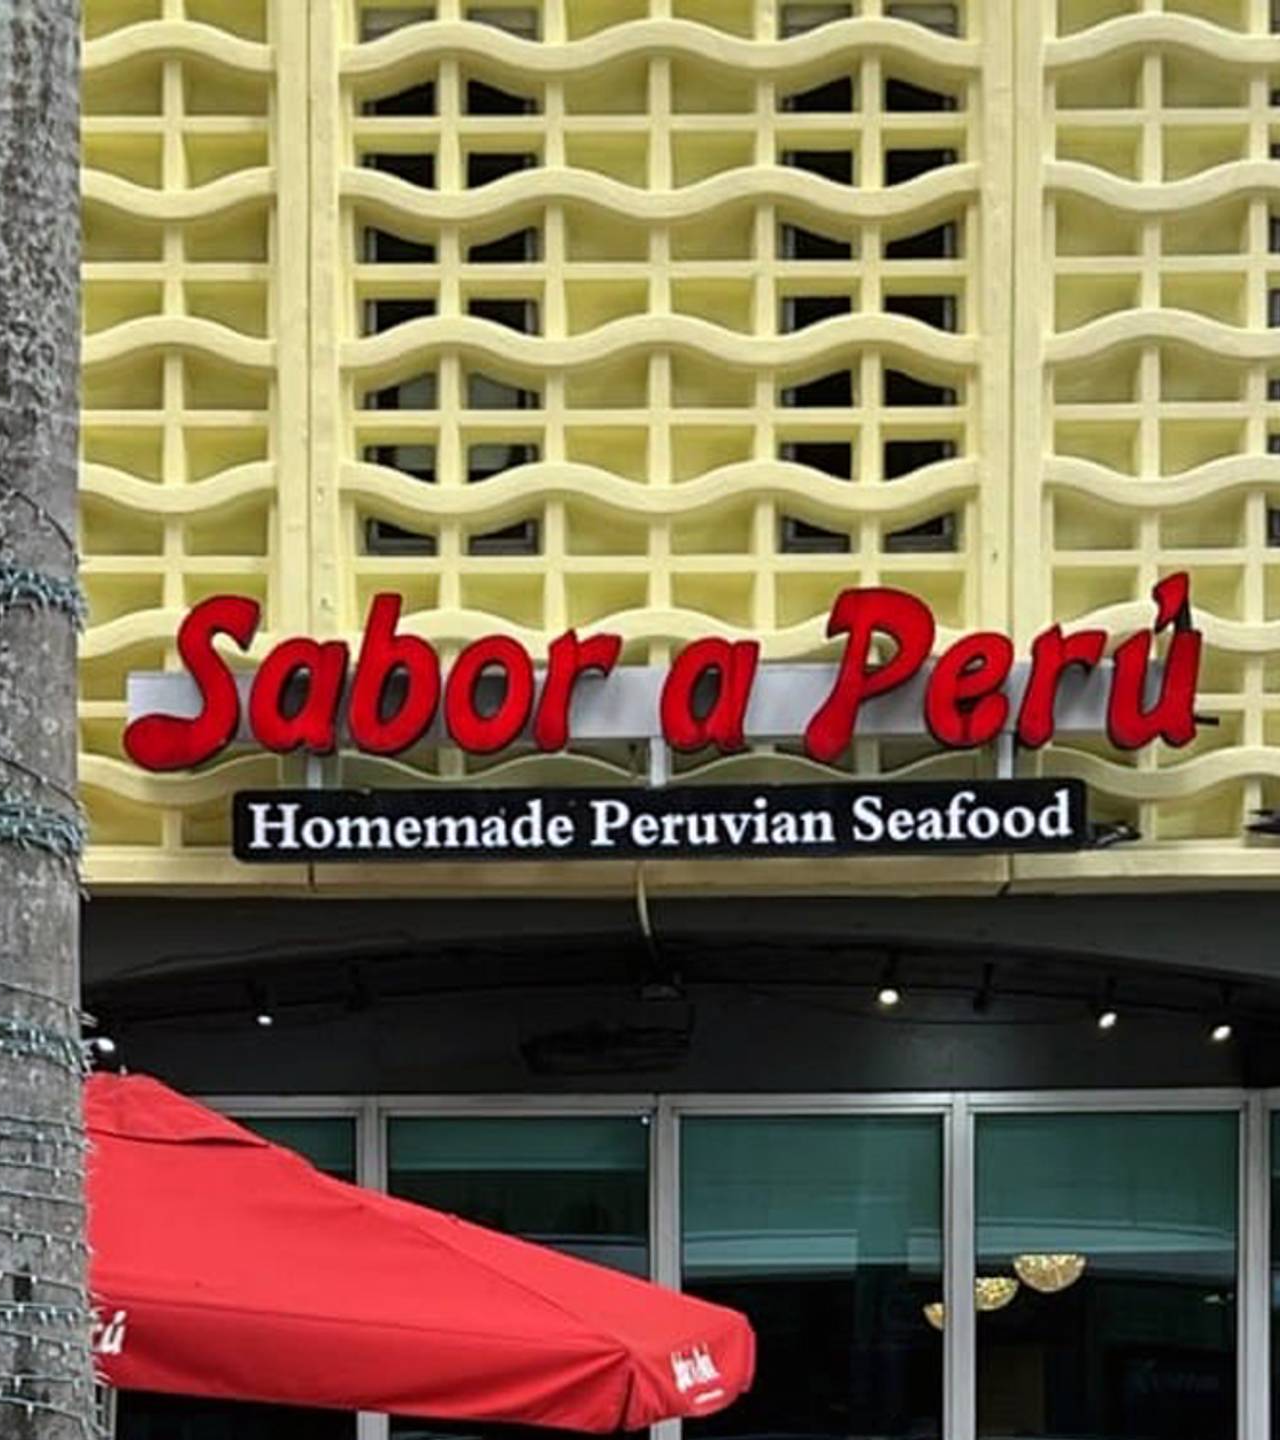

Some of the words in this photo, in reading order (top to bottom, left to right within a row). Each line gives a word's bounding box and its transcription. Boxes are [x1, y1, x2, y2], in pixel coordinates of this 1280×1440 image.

[123, 593, 623, 773] Sabor
[659, 636, 761, 754] a
[803, 571, 1203, 763] Perú
[247, 799, 575, 850] Homemade
[589, 797, 836, 847] Peruvian
[851, 788, 1074, 843] Seafood
